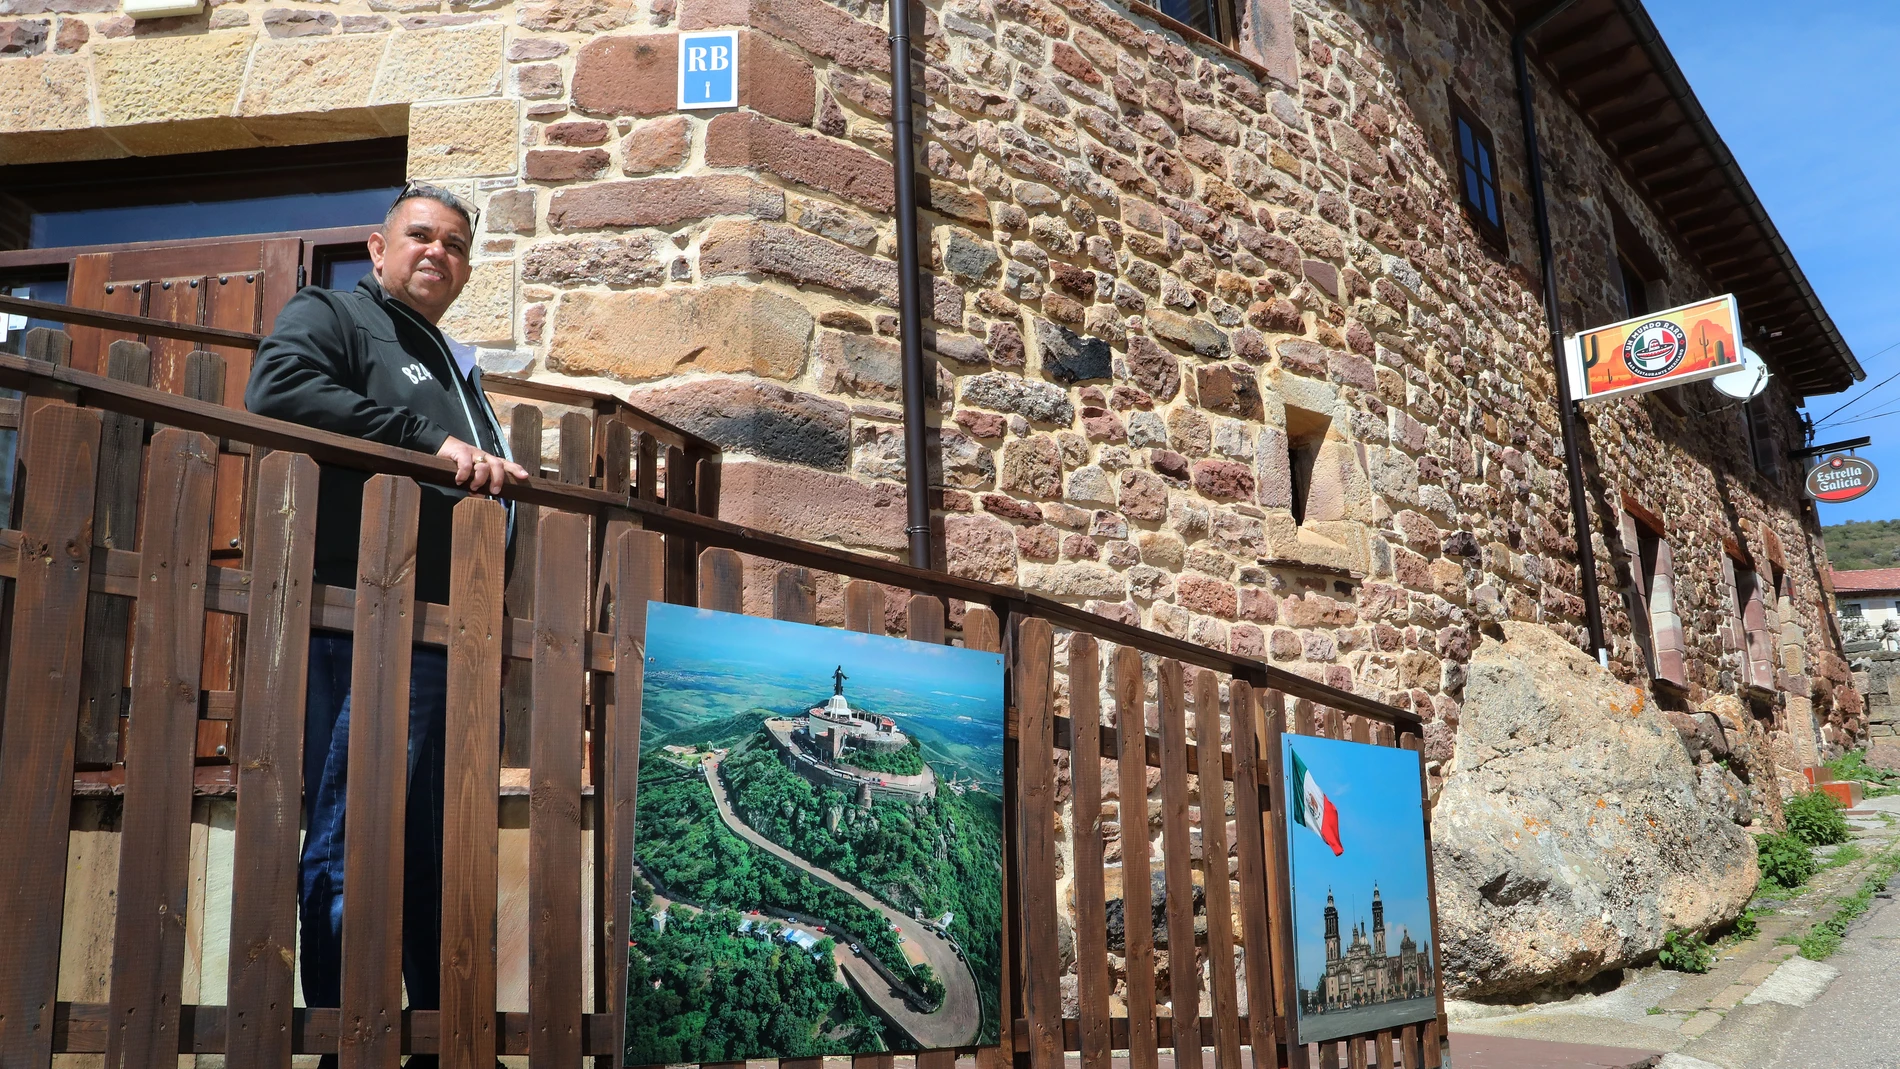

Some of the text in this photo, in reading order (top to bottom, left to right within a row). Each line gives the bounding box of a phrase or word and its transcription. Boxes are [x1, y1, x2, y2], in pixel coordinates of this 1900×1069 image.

[687, 45, 729, 72] RB
[1625, 322, 1683, 351] UN MUNDO RARO
[401, 362, 433, 385] 824
[1634, 369, 1668, 377] RESTAURANTE
[1667, 348, 1685, 371] MEXICANO
[1816, 466, 1863, 482] Estrella
[1819, 477, 1862, 492] Galicia
